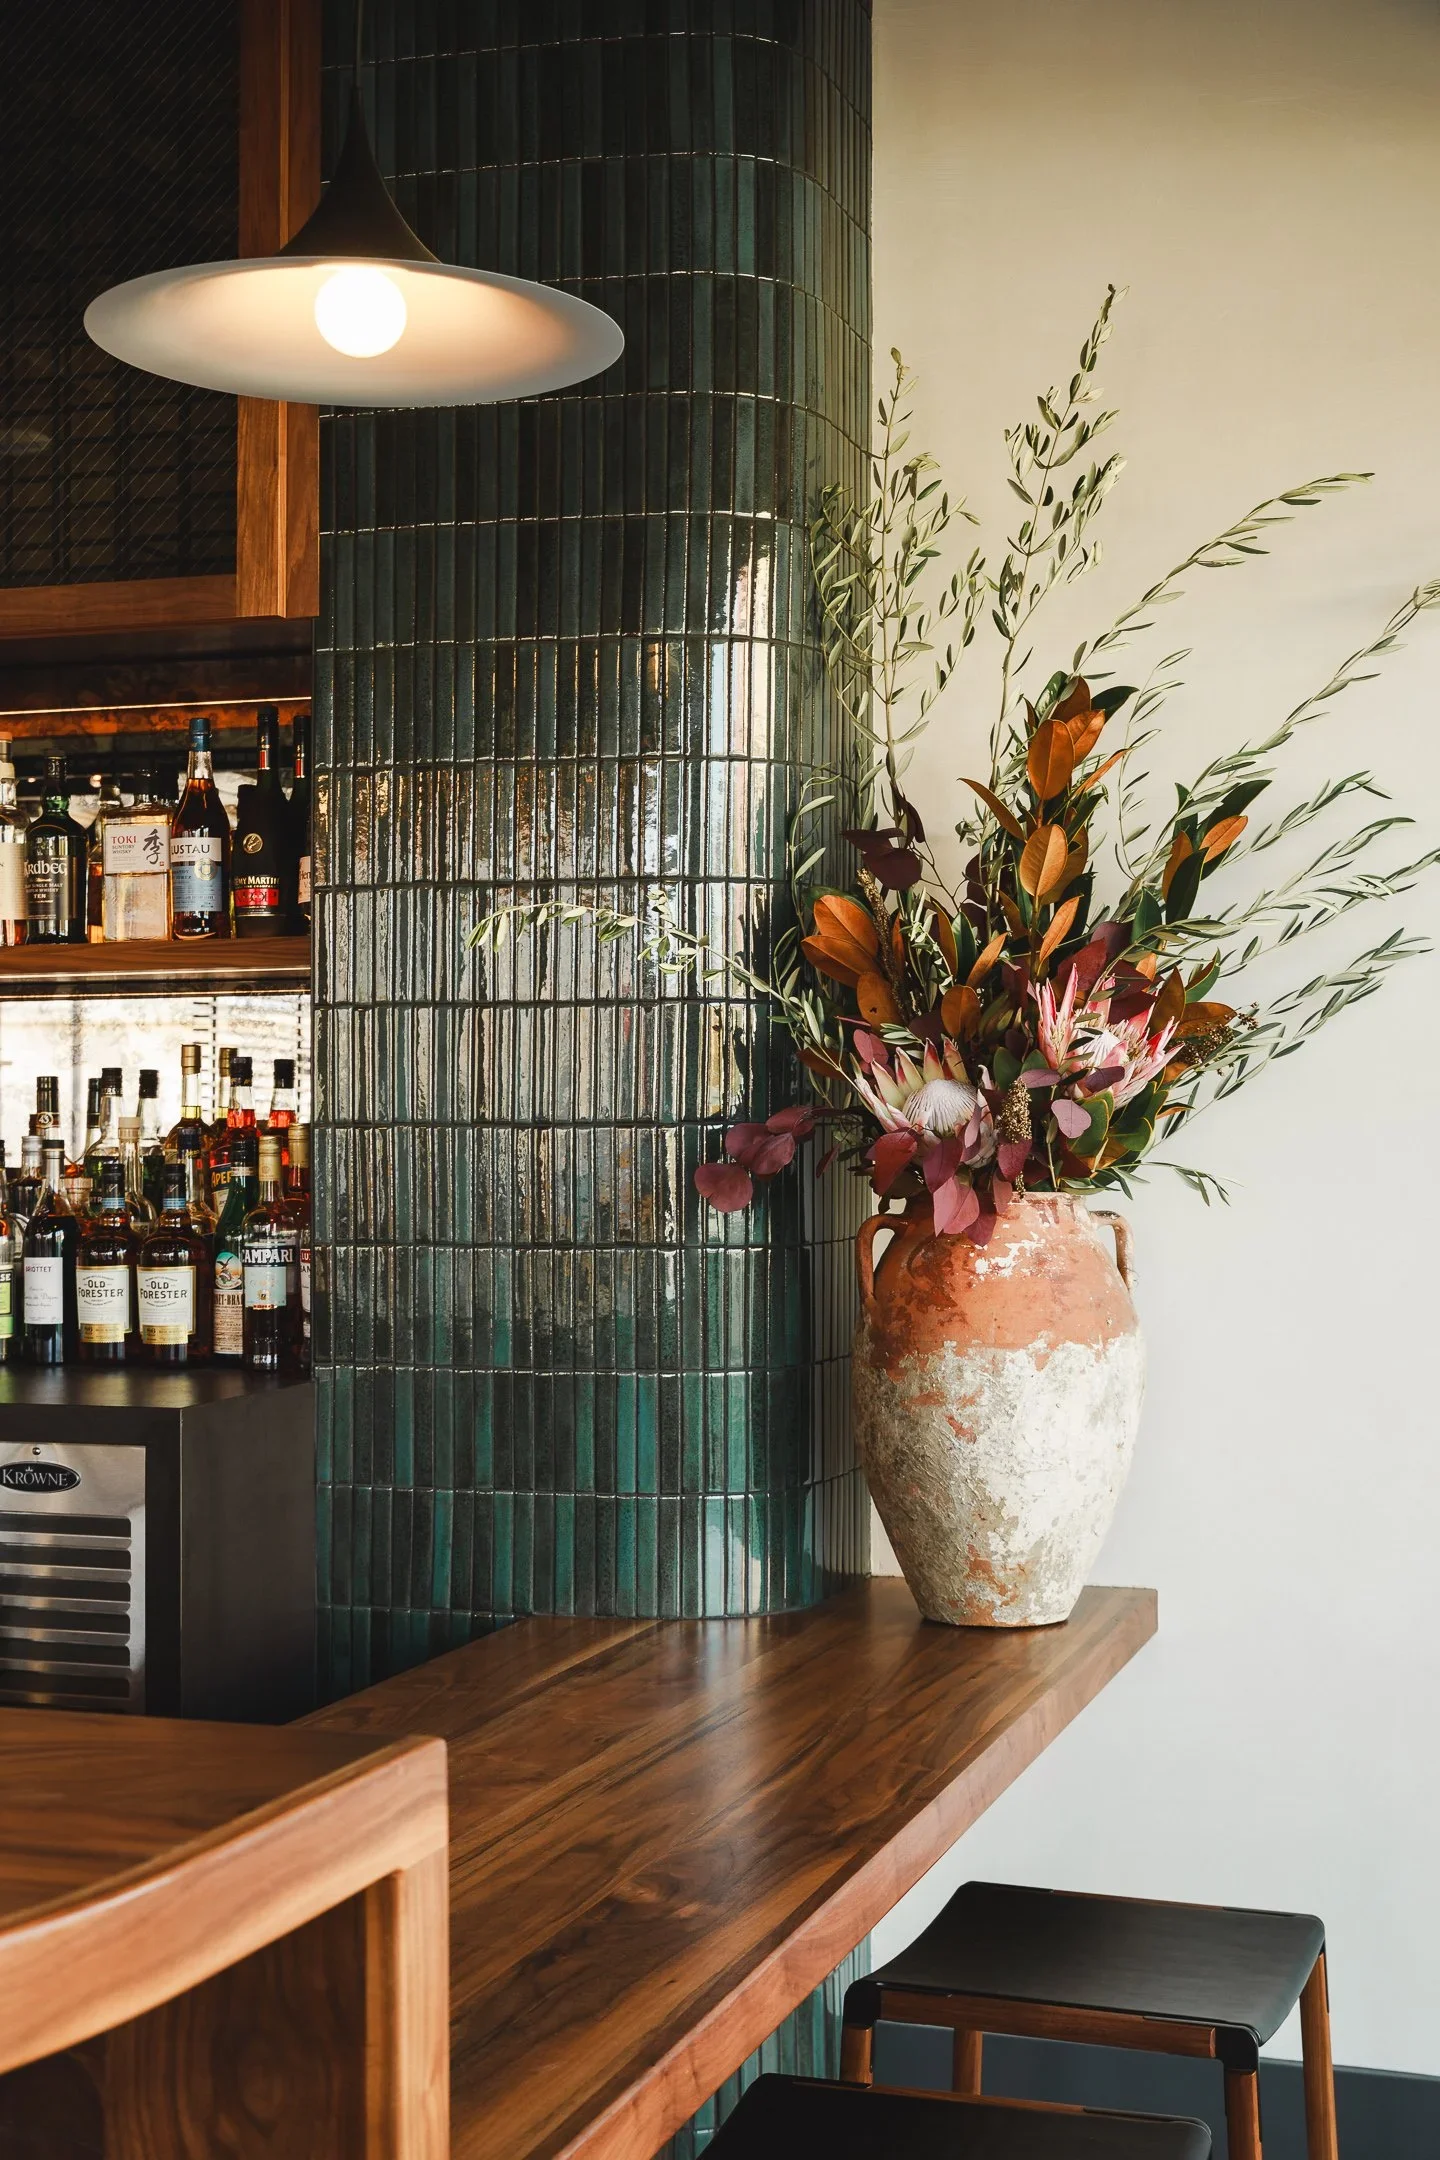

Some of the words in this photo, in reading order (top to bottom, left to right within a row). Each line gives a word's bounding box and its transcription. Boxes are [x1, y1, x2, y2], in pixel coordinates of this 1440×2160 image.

[112, 836, 137, 844] TOKI
[142, 828, 164, 865] 季
[87, 1279, 106, 1288] OLD
[150, 1280, 169, 1290] OLD
[78, 1286, 124, 1298] FORESTER
[140, 1288, 188, 1299] FORESTER
[2, 1468, 68, 1487] KROWNE
